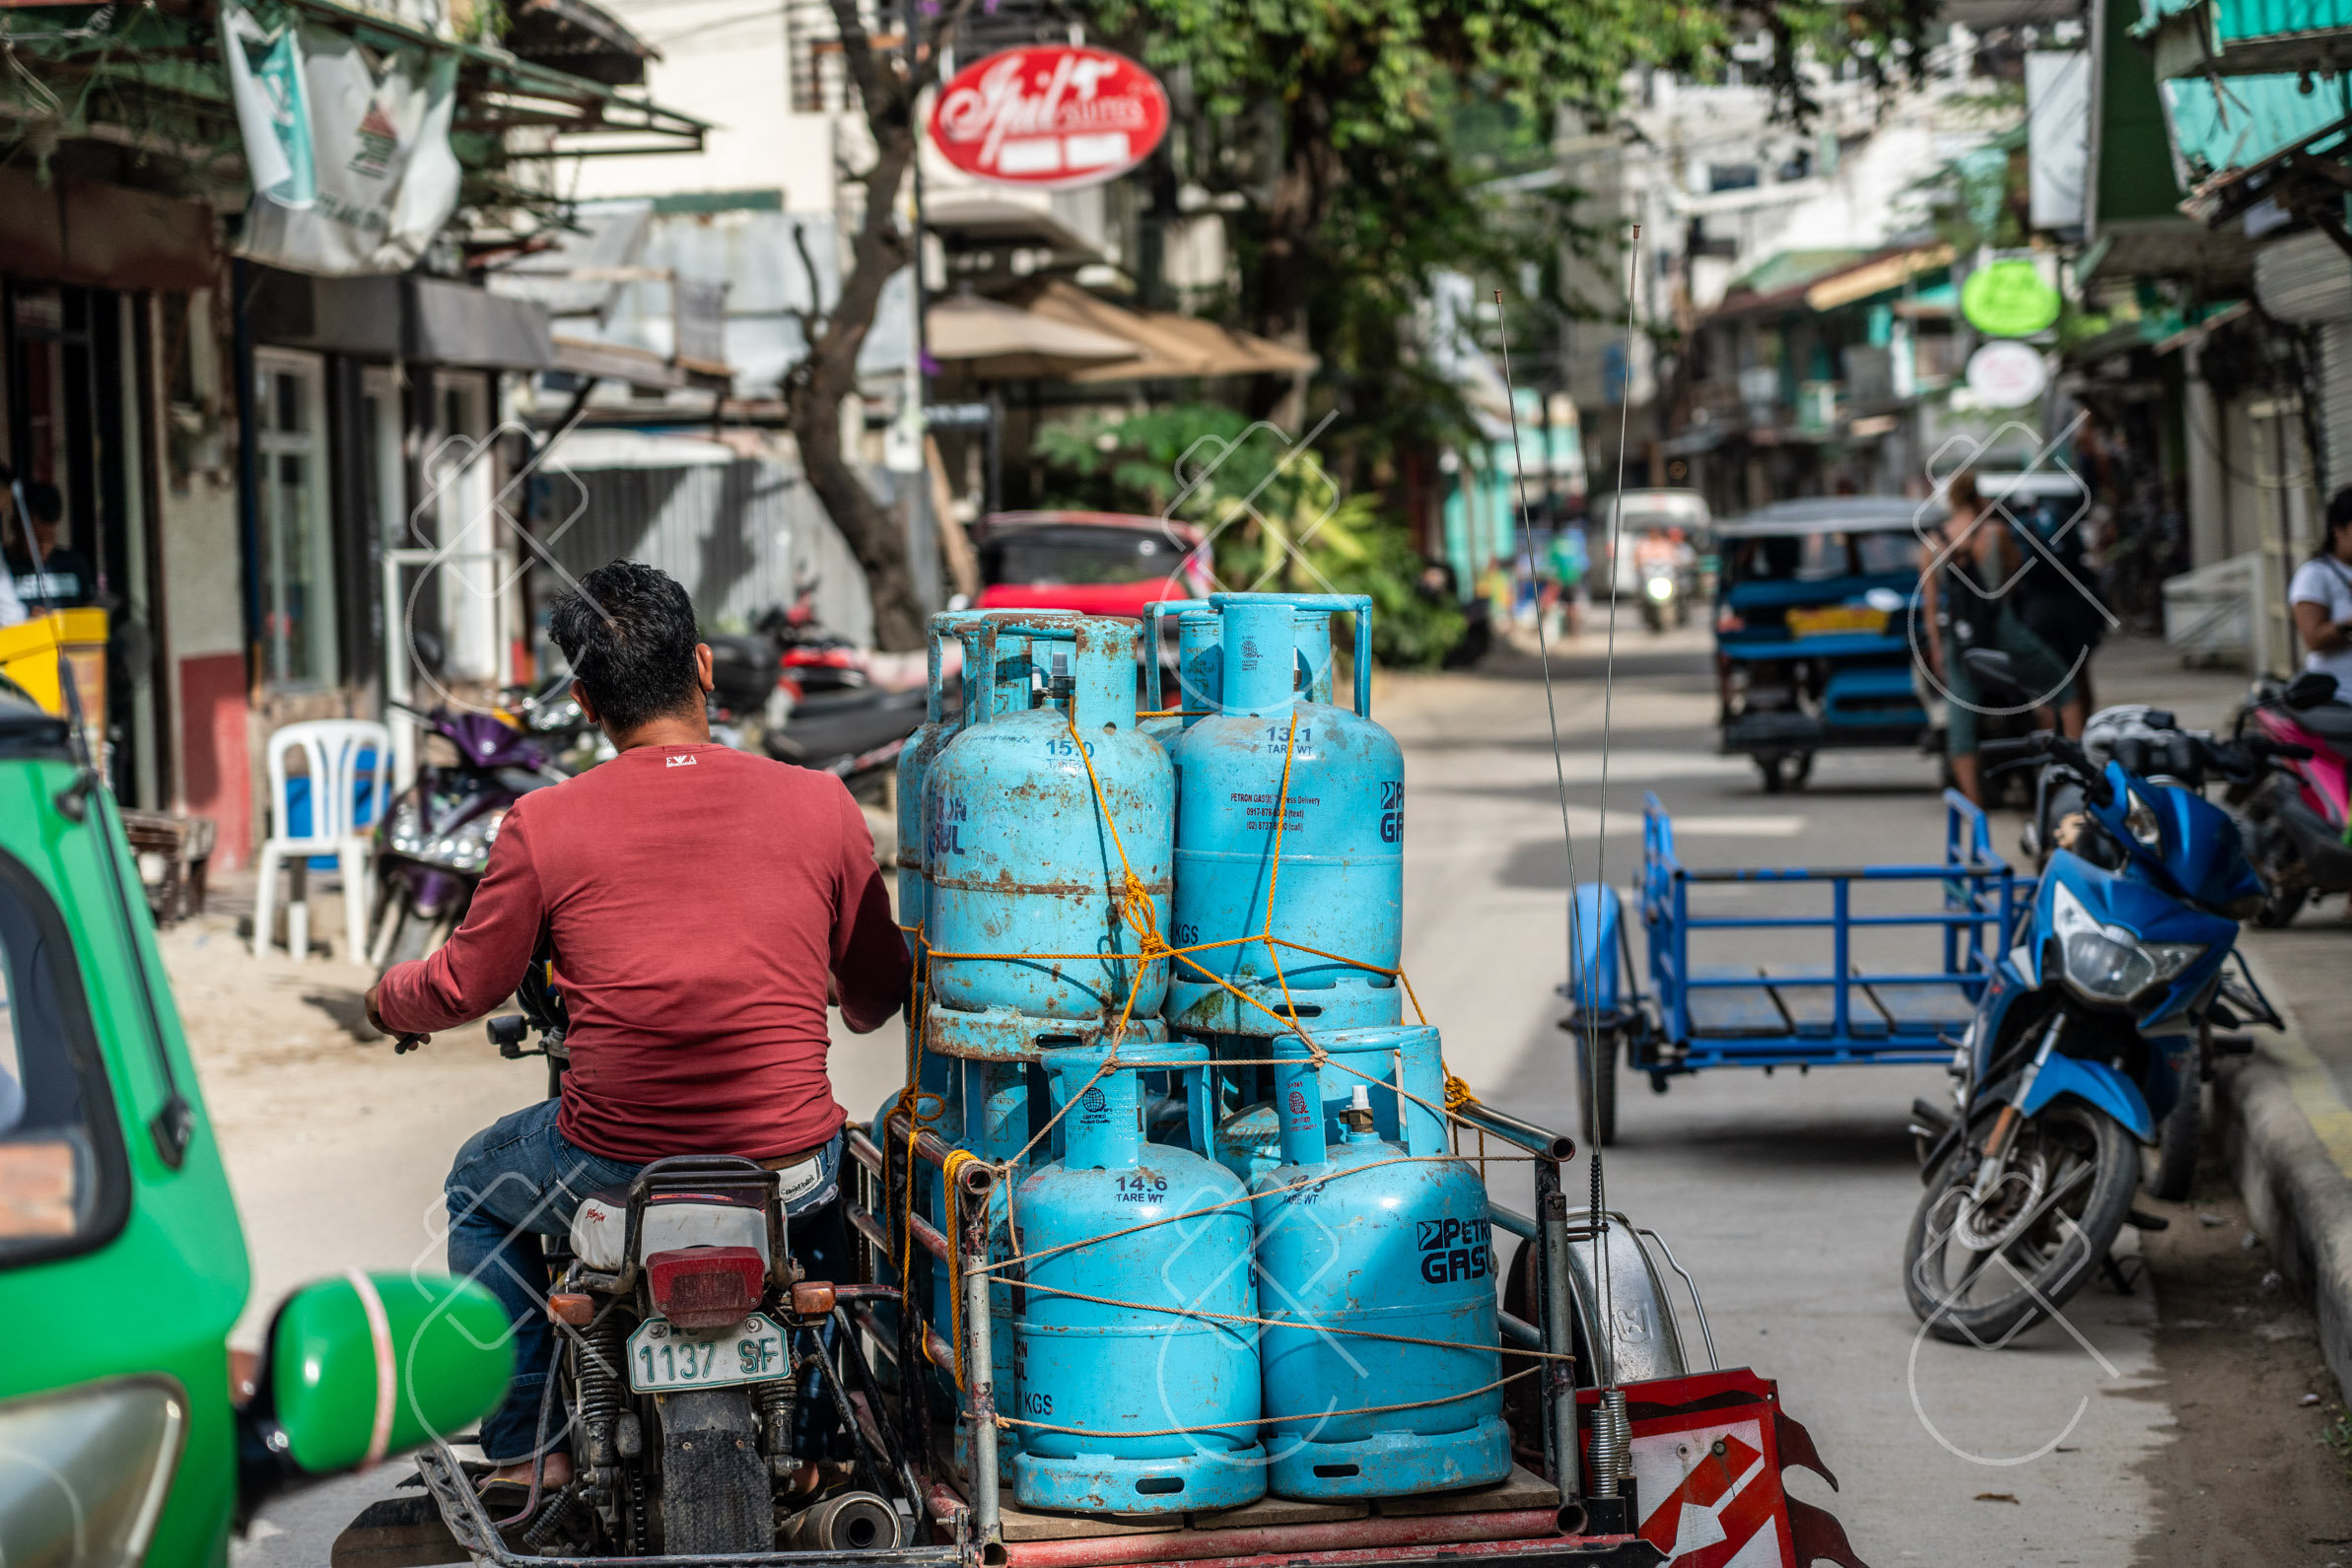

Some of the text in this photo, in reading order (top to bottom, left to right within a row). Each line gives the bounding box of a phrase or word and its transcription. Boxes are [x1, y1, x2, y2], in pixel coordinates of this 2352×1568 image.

[1266, 725, 1312, 742] 13.1
[1046, 739, 1095, 759] 15.0
[1297, 744, 1312, 756] WT
[1230, 792, 1253, 802] PETRON
[1297, 795, 1320, 807] Delivery
[1287, 808, 1304, 819] (text)
[1246, 821, 1257, 832] (02)
[1175, 922, 1199, 945] KGS
[1115, 1176, 1168, 1193] 14.6
[1116, 1193, 1165, 1204] TARE WT
[1304, 1193, 1319, 1205] WT
[639, 1336, 779, 1383] 1137 SF
[1024, 1391, 1054, 1416] KGS
